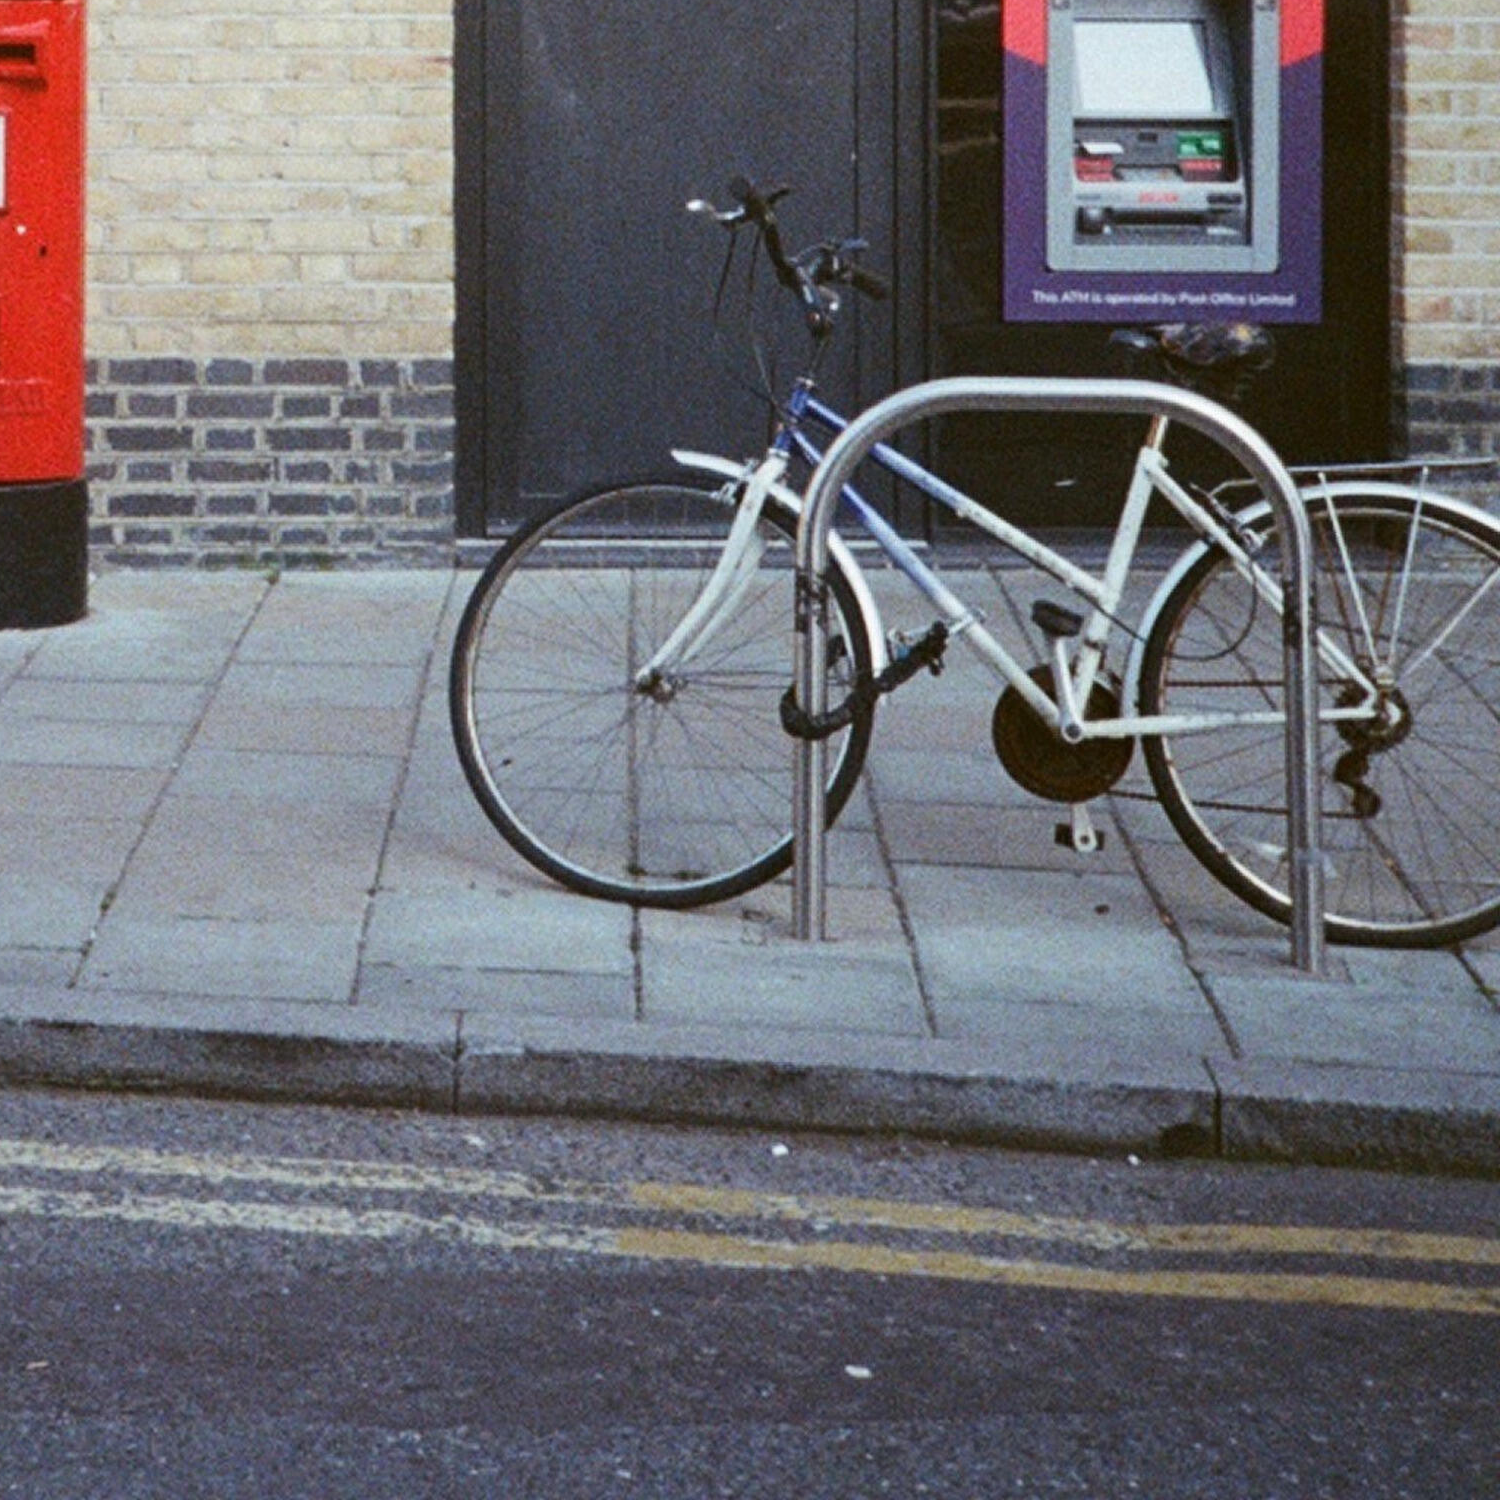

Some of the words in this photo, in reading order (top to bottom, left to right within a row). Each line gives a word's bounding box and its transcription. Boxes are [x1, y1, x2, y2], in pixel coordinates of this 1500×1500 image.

[1032, 289, 1058, 304] This
[1060, 290, 1089, 304] ATM
[1091, 291, 1103, 304] is
[1104, 291, 1158, 306] operated
[1160, 291, 1177, 307] by
[1178, 291, 1207, 305] Post
[1210, 291, 1246, 306] Office
[1249, 293, 1296, 308] Limited
